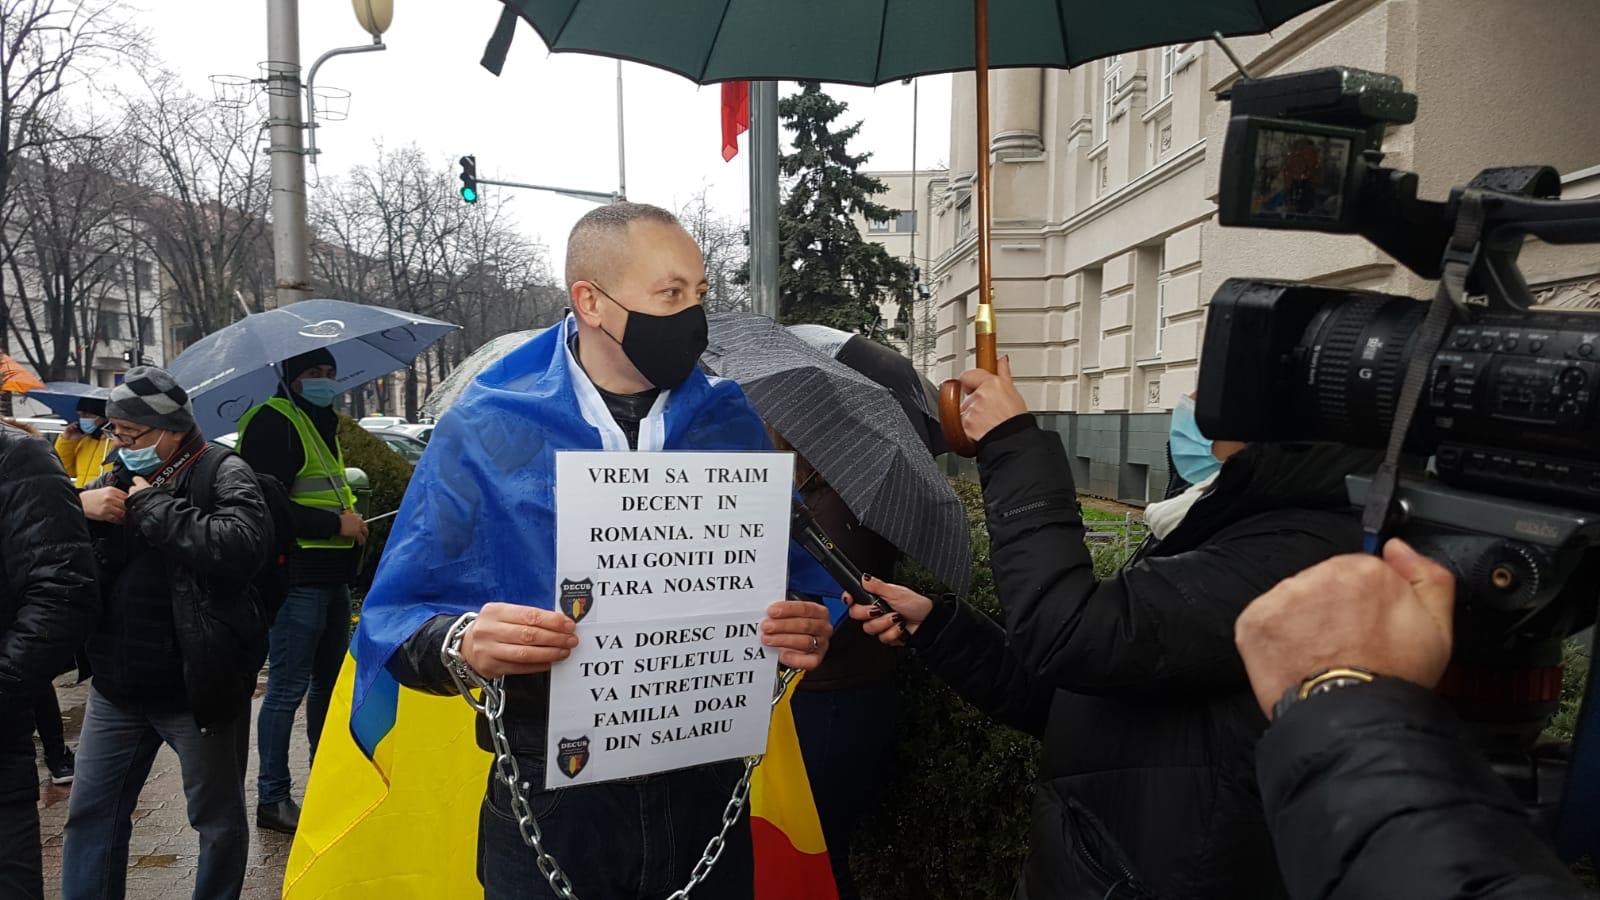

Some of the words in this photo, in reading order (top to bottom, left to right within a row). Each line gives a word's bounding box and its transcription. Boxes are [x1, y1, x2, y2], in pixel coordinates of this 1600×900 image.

[1359, 368, 1372, 379] G
[162, 466, 174, 476] 5D
[588, 467, 649, 484] VREM
[665, 467, 689, 484] SA
[704, 468, 768, 483] TRAIM
[622, 495, 704, 512] DECENT
[718, 494, 737, 510] IN
[590, 525, 694, 543] ROMANIA.
[703, 524, 730, 540] NU
[739, 523, 764, 538] NE
[596, 553, 637, 570] MAI
[643, 550, 714, 568] GONITI
[724, 548, 757, 565] DIN
[596, 580, 654, 597] TARA
[663, 575, 755, 594] NOASTRA
[595, 635, 623, 649] VA
[635, 627, 715, 647] DORESC
[725, 623, 759, 638] DIN
[580, 660, 624, 677] TOT
[634, 649, 734, 674] SUFLETUL
[744, 644, 767, 660] SA
[590, 687, 618, 702] VA
[630, 670, 755, 699] INTRETINETI
[593, 705, 680, 727] FAMILIA
[694, 695, 747, 714] DOAR
[561, 740, 588, 749] DECUS
[605, 733, 641, 751] DIN
[650, 719, 734, 745] SALARIU
